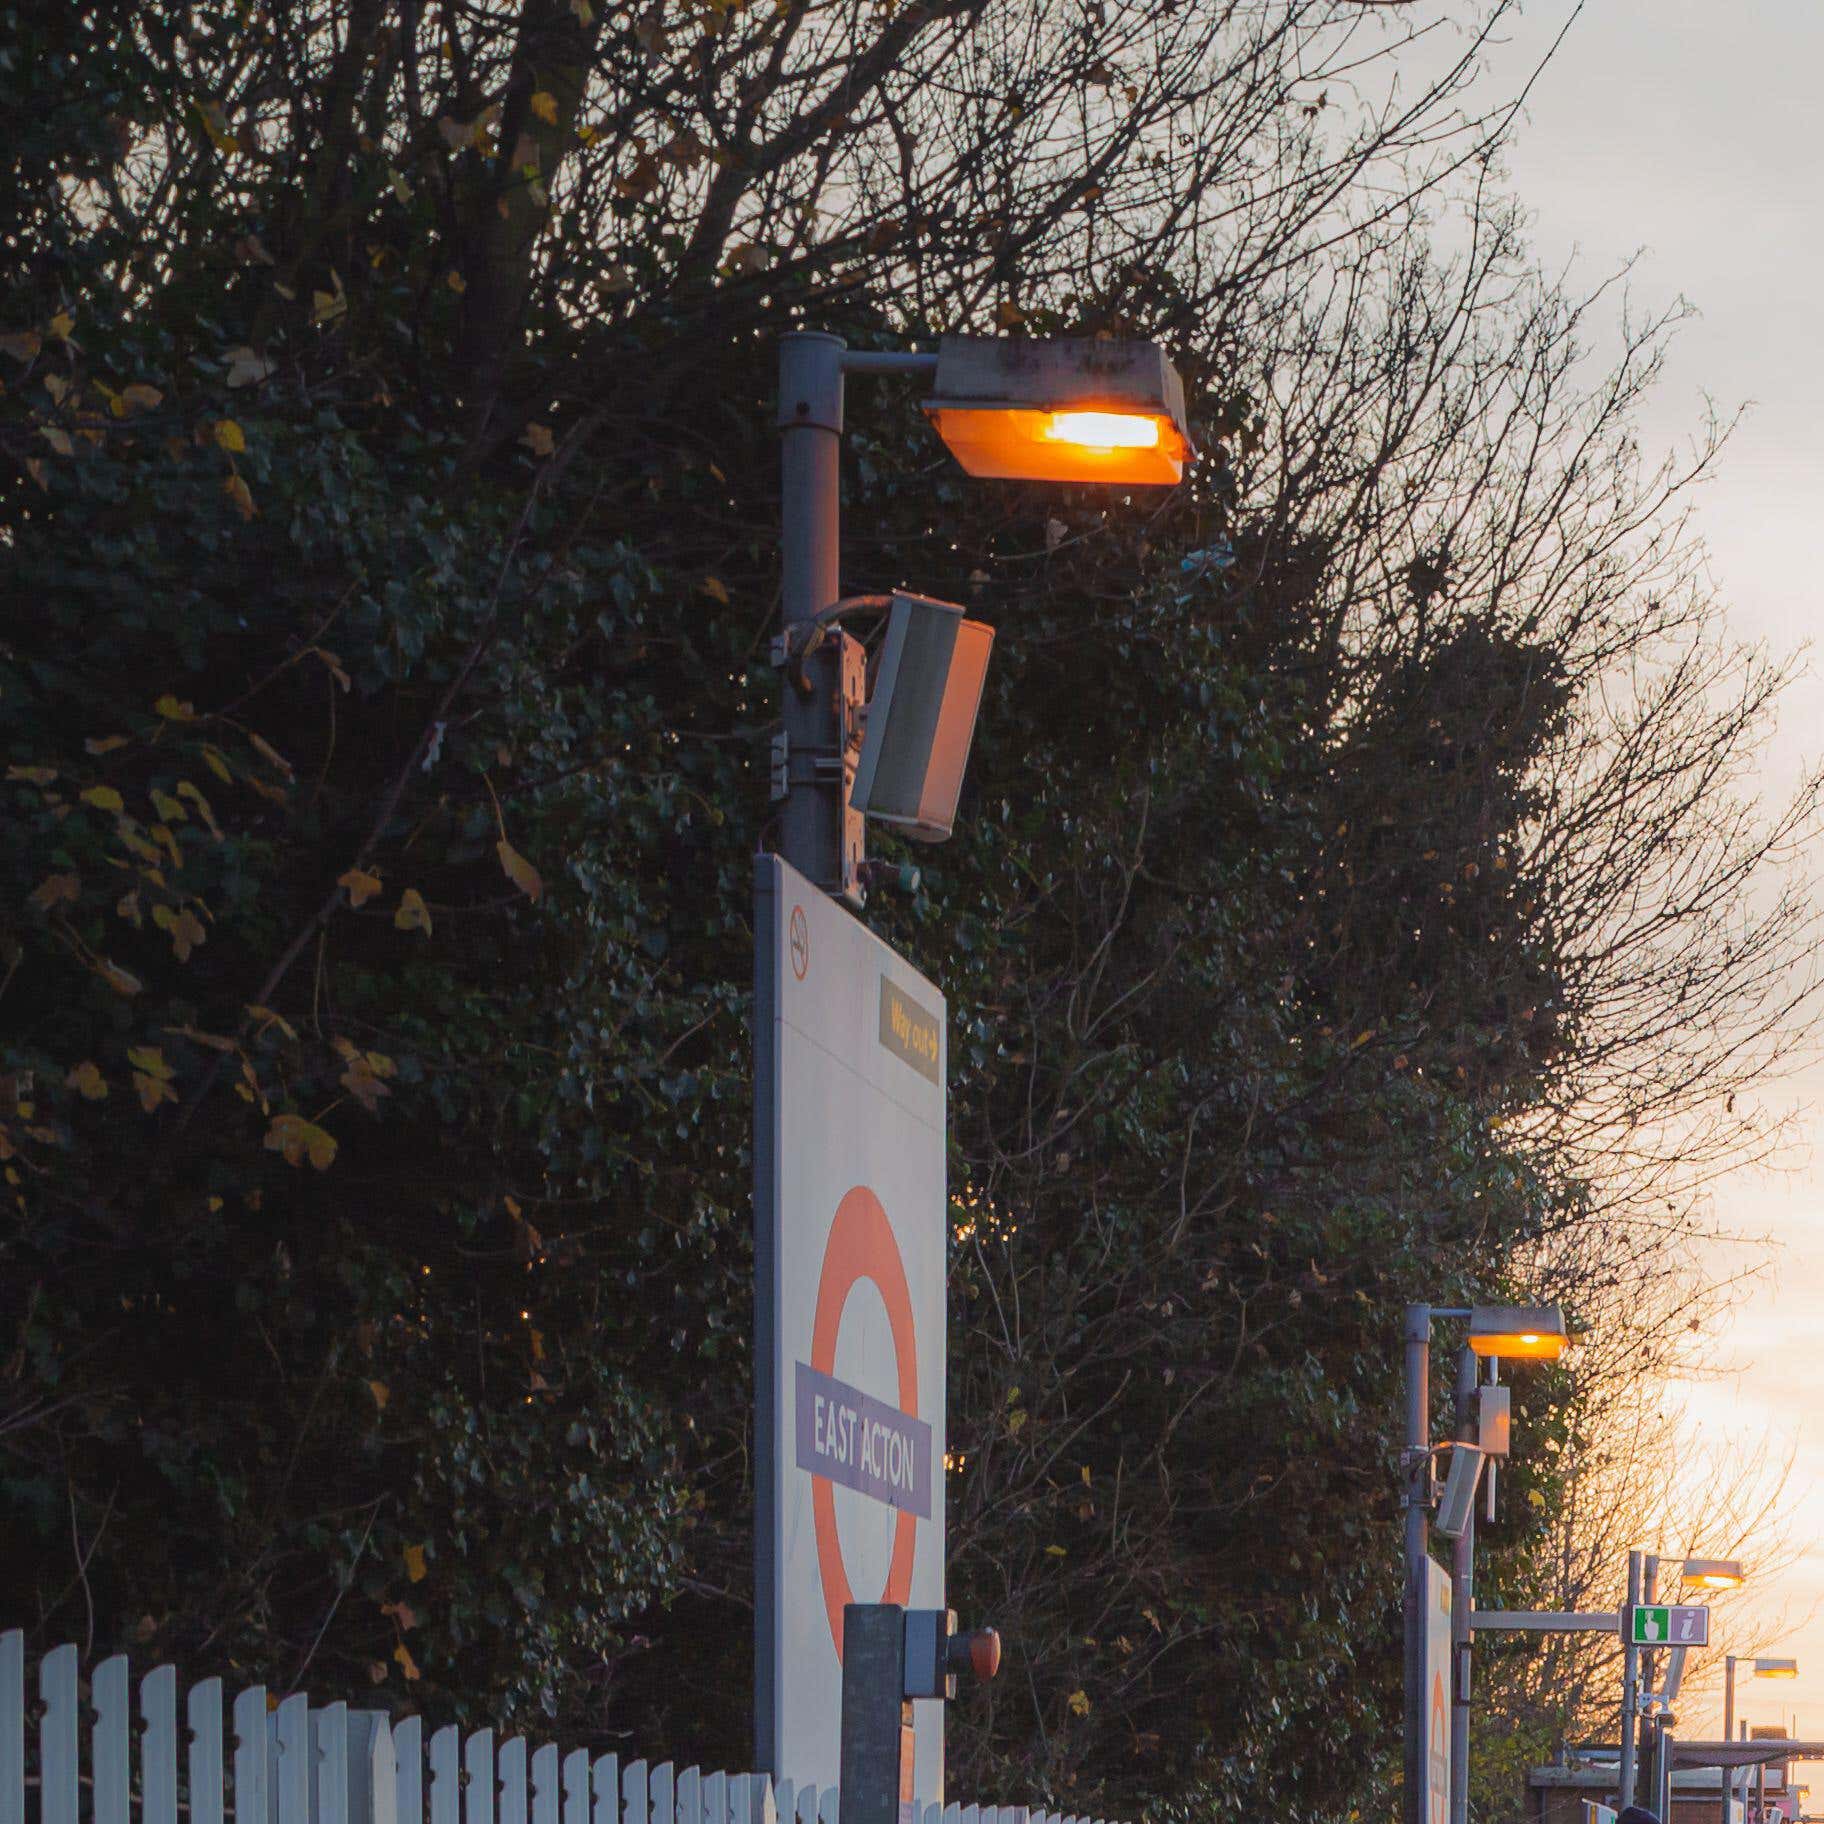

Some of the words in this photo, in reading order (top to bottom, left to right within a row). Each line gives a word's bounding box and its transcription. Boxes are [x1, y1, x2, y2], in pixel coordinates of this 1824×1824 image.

[891, 998, 911, 1048] Way
[912, 1024, 928, 1056] out
[815, 1394, 857, 1466] EAST
[861, 1417, 914, 1492] ACTON
